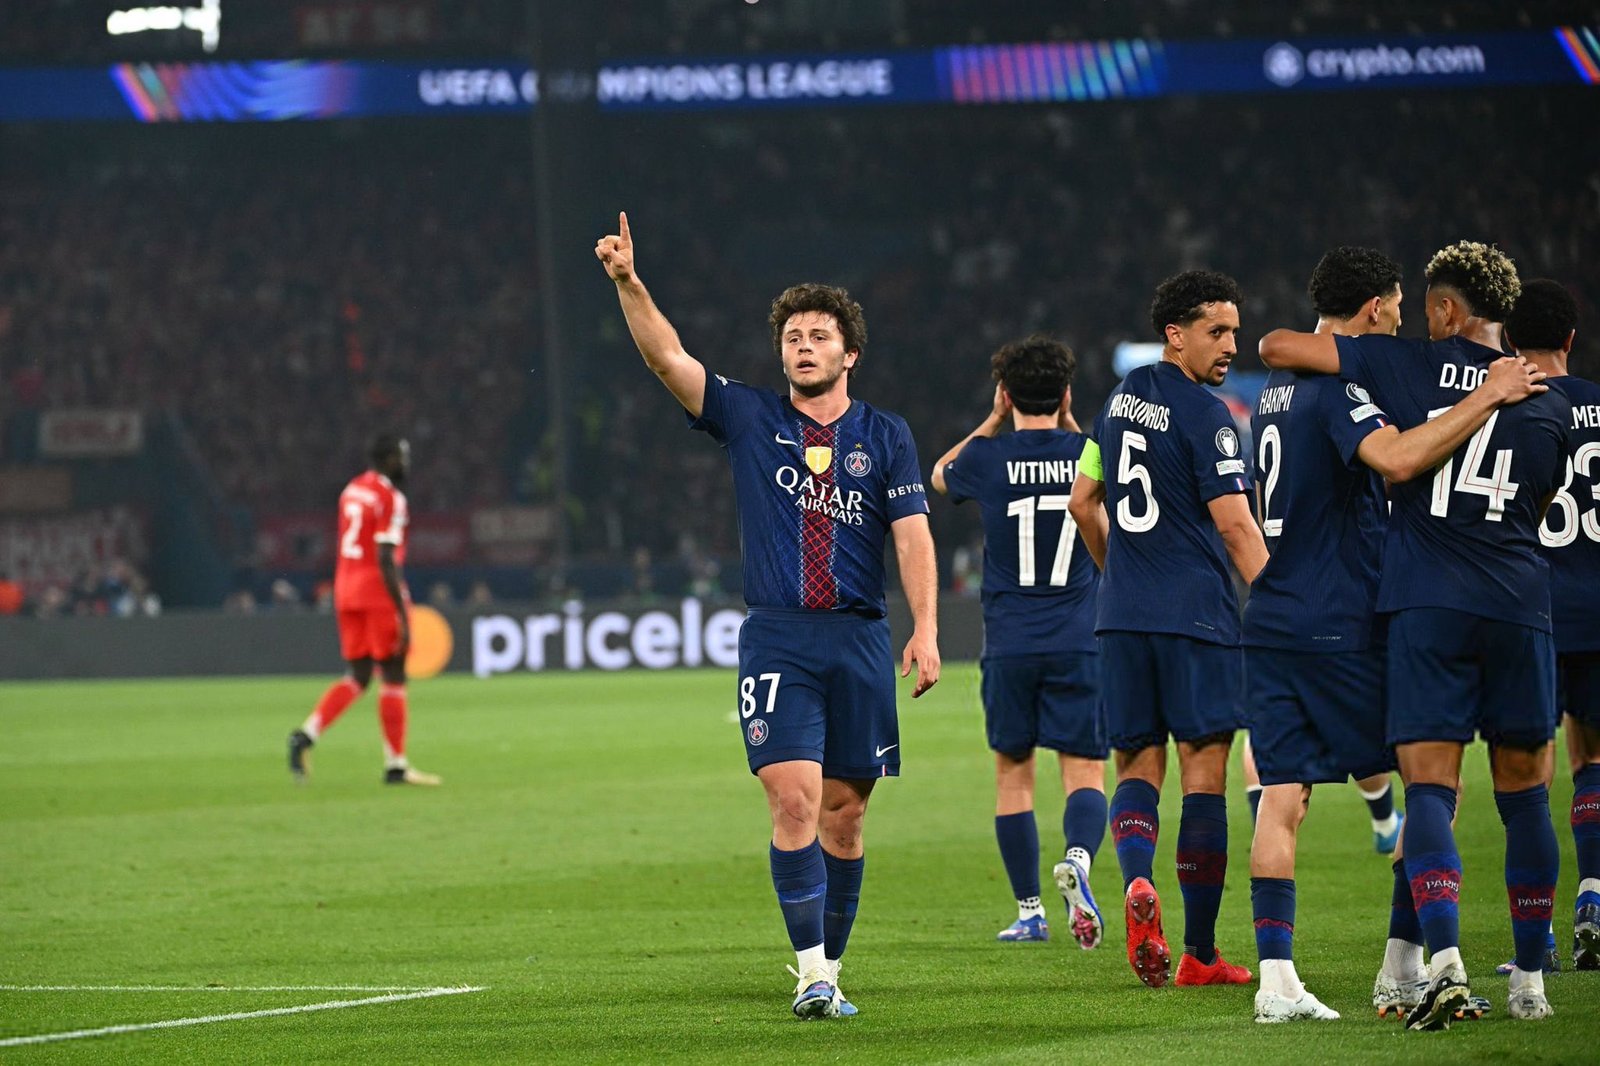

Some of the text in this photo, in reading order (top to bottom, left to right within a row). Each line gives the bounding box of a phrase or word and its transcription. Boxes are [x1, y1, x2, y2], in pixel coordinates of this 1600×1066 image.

[418, 59, 893, 105] UEFA CMPIONS LEAGUE
[1306, 43, 1485, 81] crypto.com
[1258, 384, 1295, 416] HAKIMI
[1117, 430, 1160, 533] 5
[1259, 423, 1284, 537] 2
[1427, 404, 1520, 522] 14
[775, 465, 863, 511] QATAR
[795, 494, 863, 526] AIRWAYS
[341, 502, 364, 559] 2
[1007, 495, 1078, 587] 17
[472, 597, 745, 679] pricele
[740, 672, 782, 719] 87
[1119, 818, 1153, 831] PARIS
[1425, 879, 1459, 892] PARIS
[1517, 897, 1553, 907] PARIS
